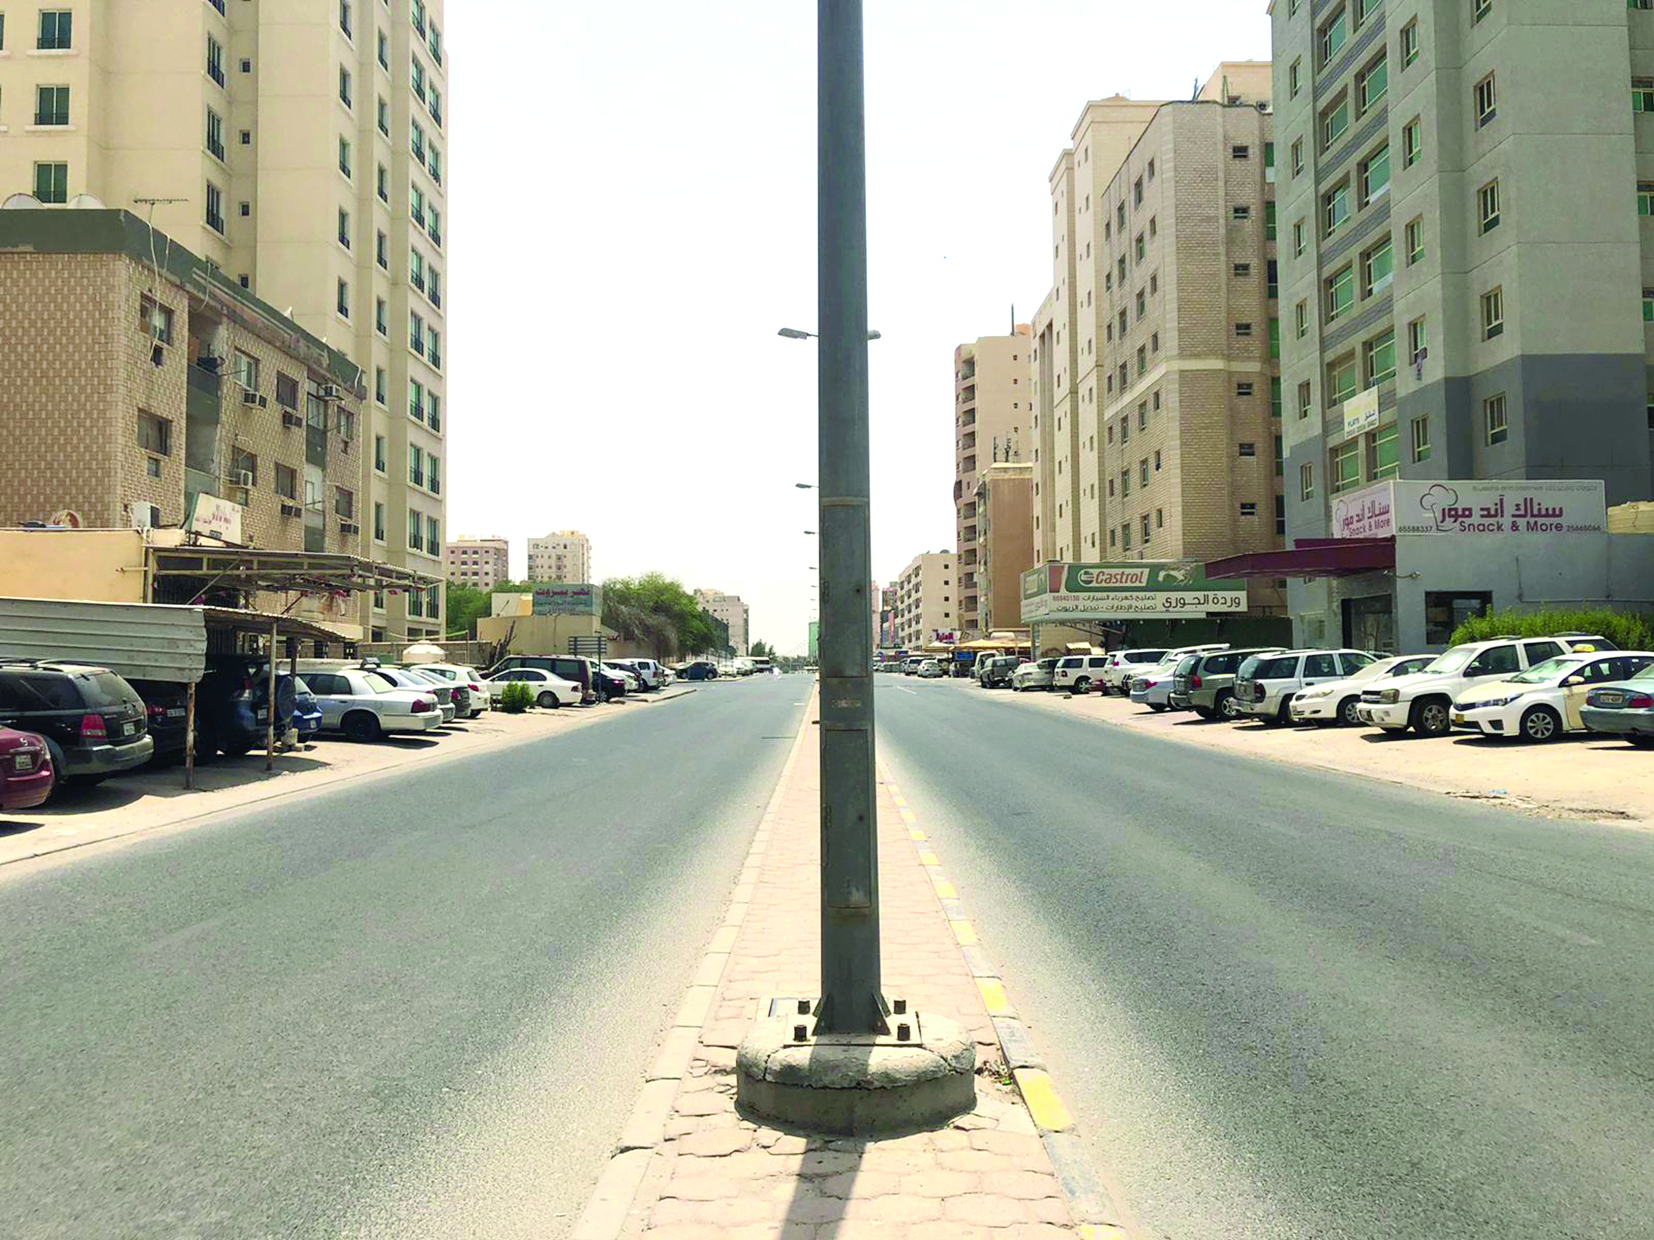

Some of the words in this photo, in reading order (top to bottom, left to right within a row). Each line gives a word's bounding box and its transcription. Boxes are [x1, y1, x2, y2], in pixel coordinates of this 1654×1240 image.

[1440, 505, 1473, 523] مور
[1511, 497, 1564, 519] سناك
[1458, 520, 1504, 533] Snack
[1511, 521, 1522, 532] &
[1526, 521, 1564, 533] More
[1095, 570, 1144, 585] Castrol
[1135, 594, 1157, 602] تصليح
[1212, 593, 1241, 608] وردة
